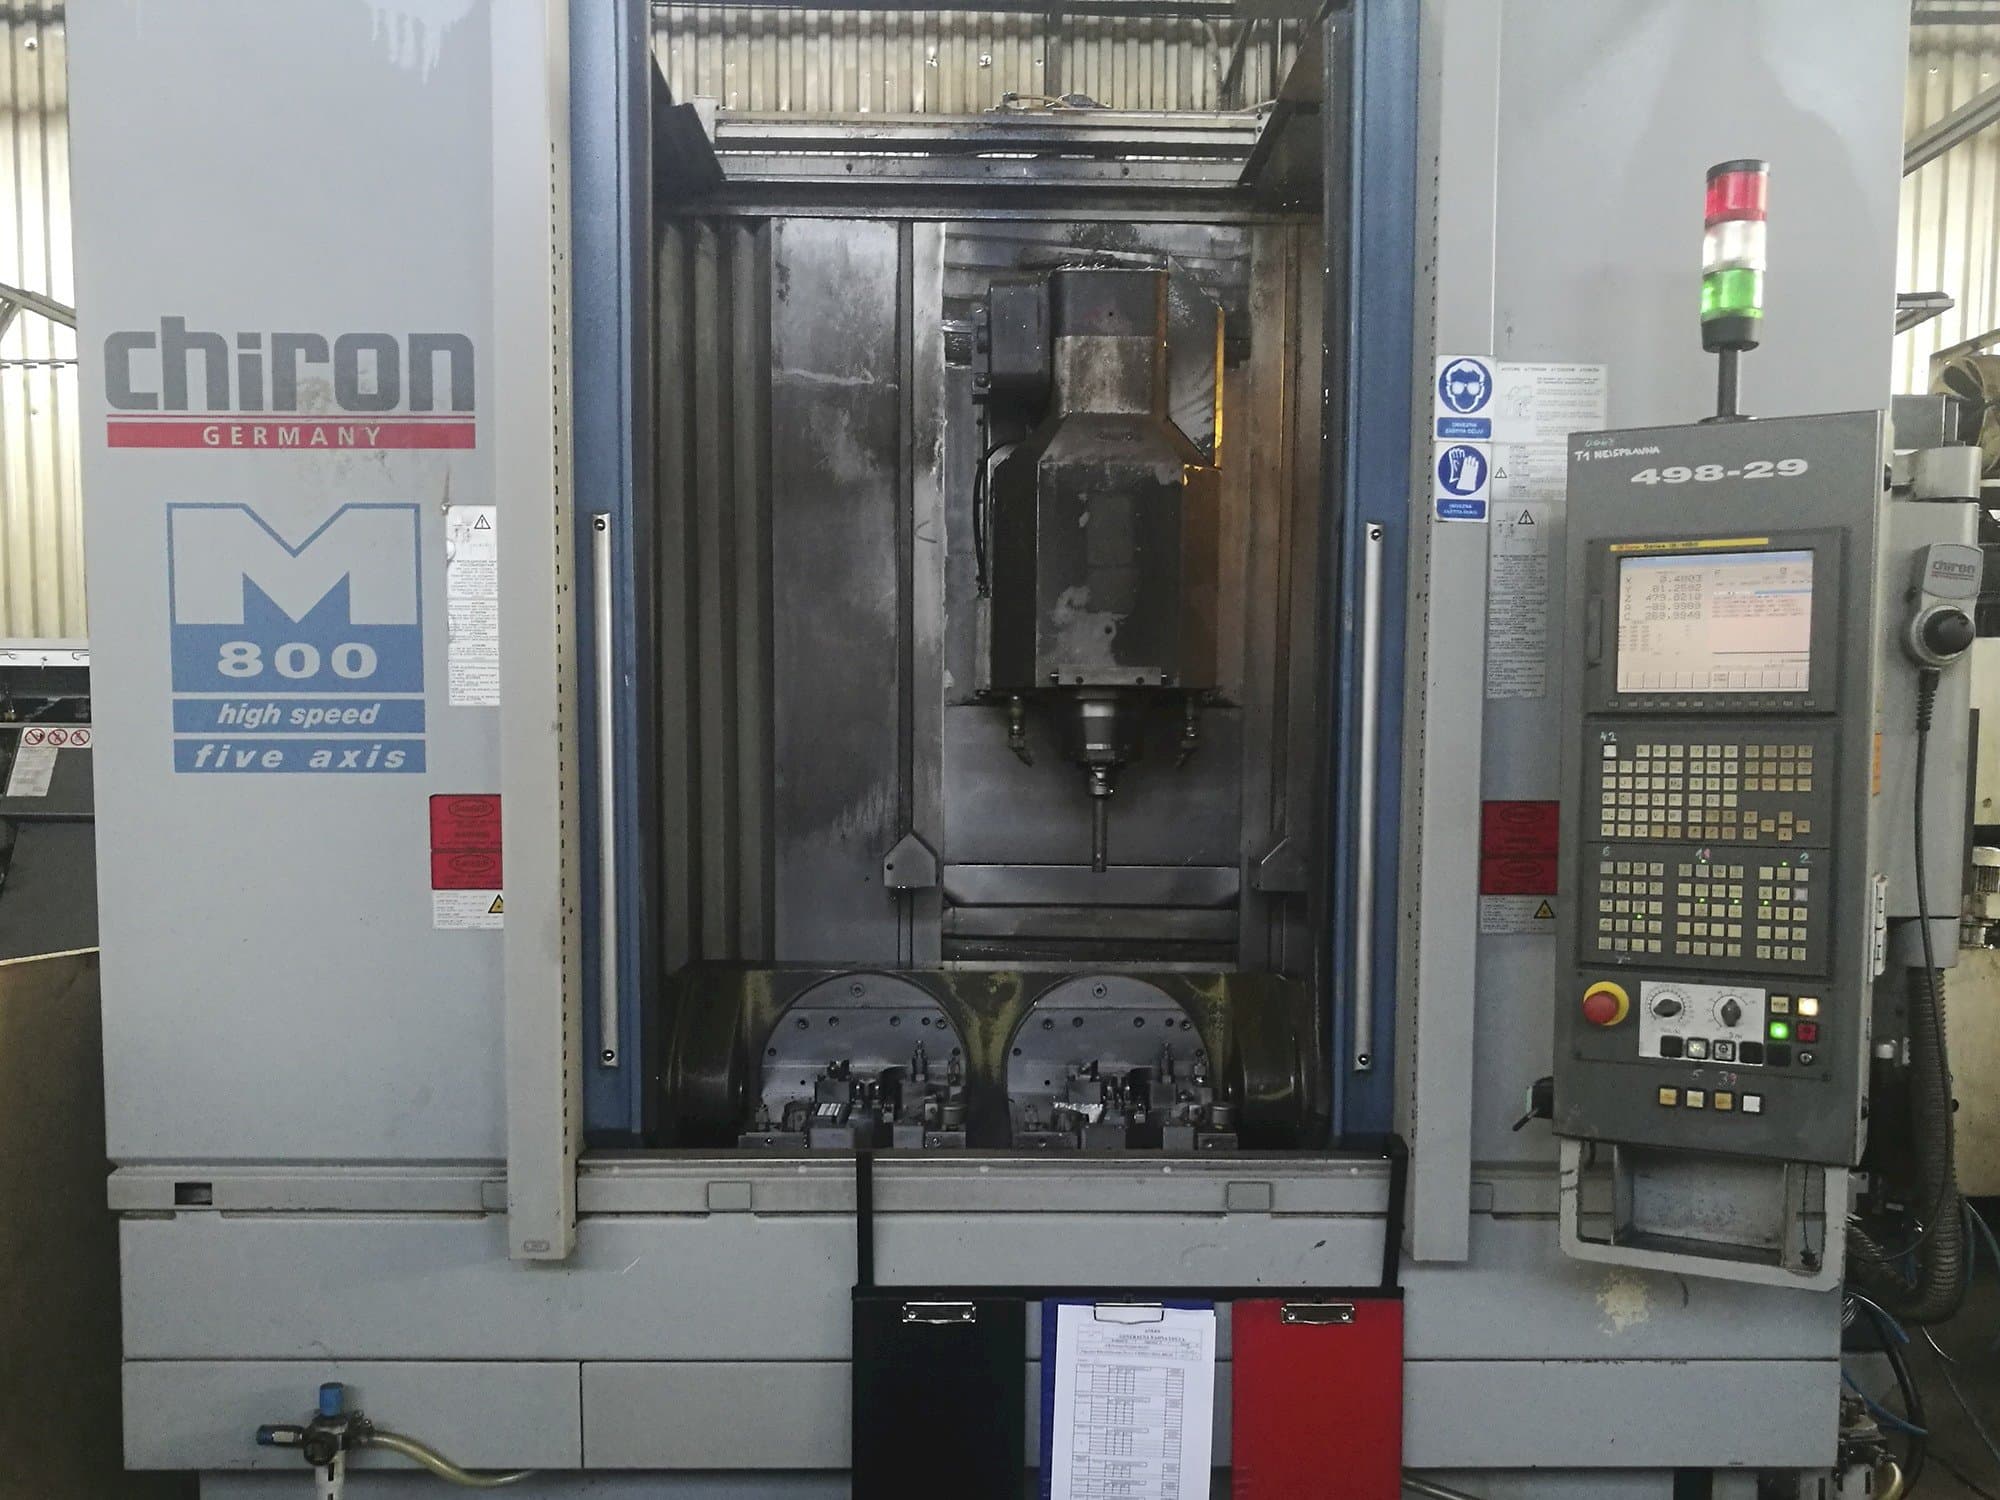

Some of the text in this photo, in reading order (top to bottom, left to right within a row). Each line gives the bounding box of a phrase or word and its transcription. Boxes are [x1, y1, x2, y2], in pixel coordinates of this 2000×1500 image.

[103, 316, 475, 412] chiron
[203, 424, 384, 447] GERMANY
[1574, 450, 1590, 462] T1
[1630, 458, 1809, 486] 498-29
[1933, 560, 1975, 574] chiron
[217, 642, 377, 679] 800
[217, 703, 381, 728] high speed
[194, 744, 406, 769] five axis
